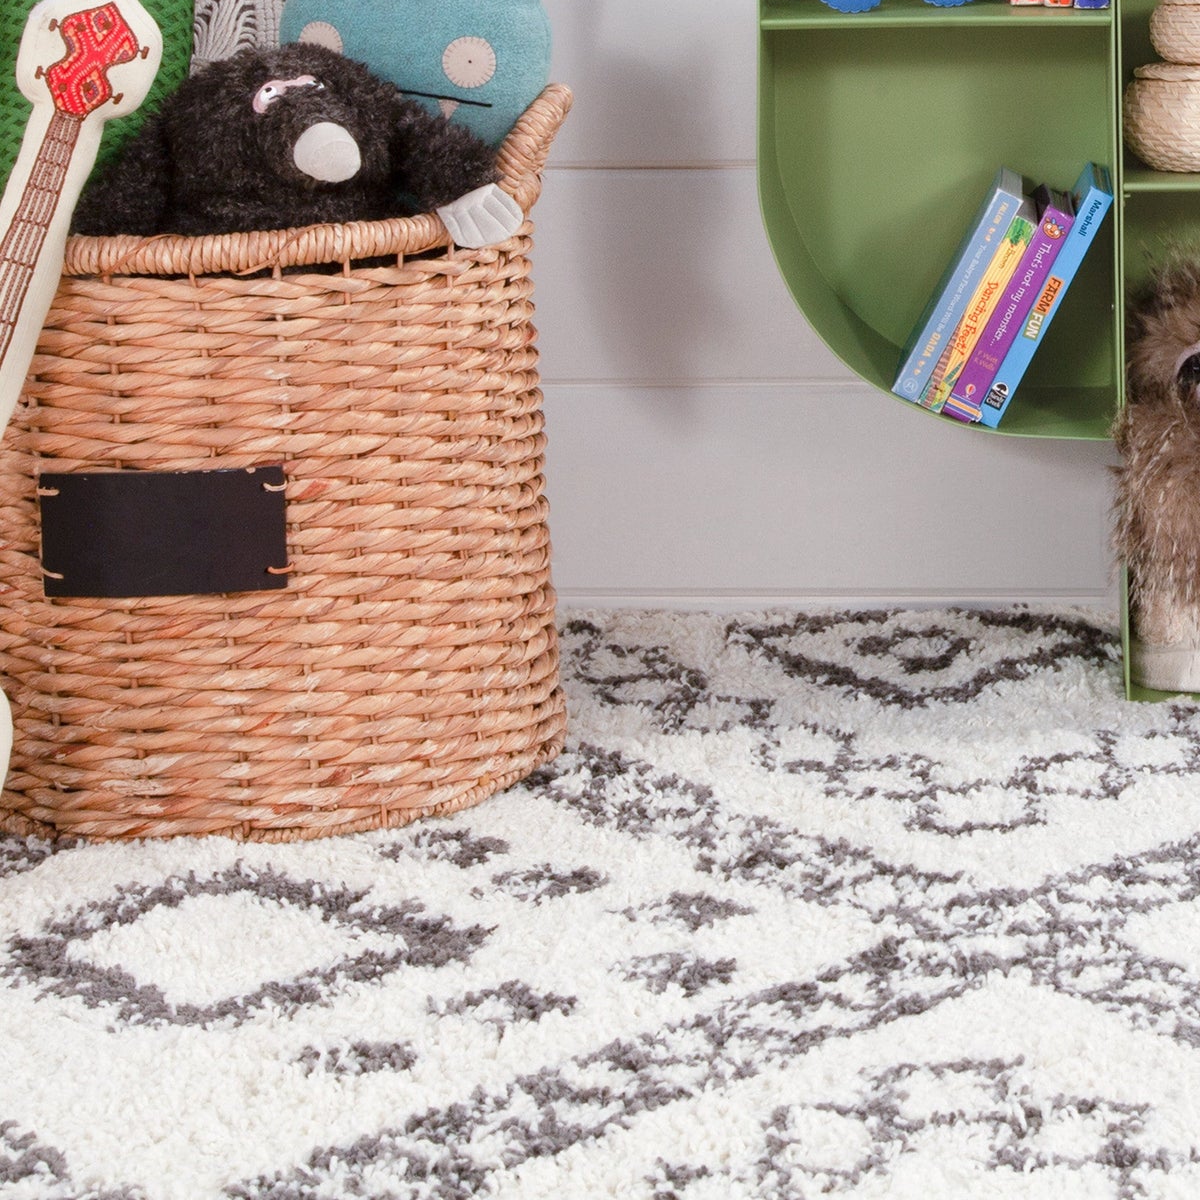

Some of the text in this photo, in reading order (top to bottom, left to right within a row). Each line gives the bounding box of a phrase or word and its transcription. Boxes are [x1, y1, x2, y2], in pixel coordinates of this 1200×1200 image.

[1078, 199, 1102, 237] Marshall
[1030, 241, 1053, 270] That's
[1021, 269, 1037, 288] not
[1010, 285, 1026, 304] my
[1022, 277, 1062, 340] FARM FUN
[952, 279, 1000, 356] Dancing Feet!
[922, 332, 942, 359] DADA
